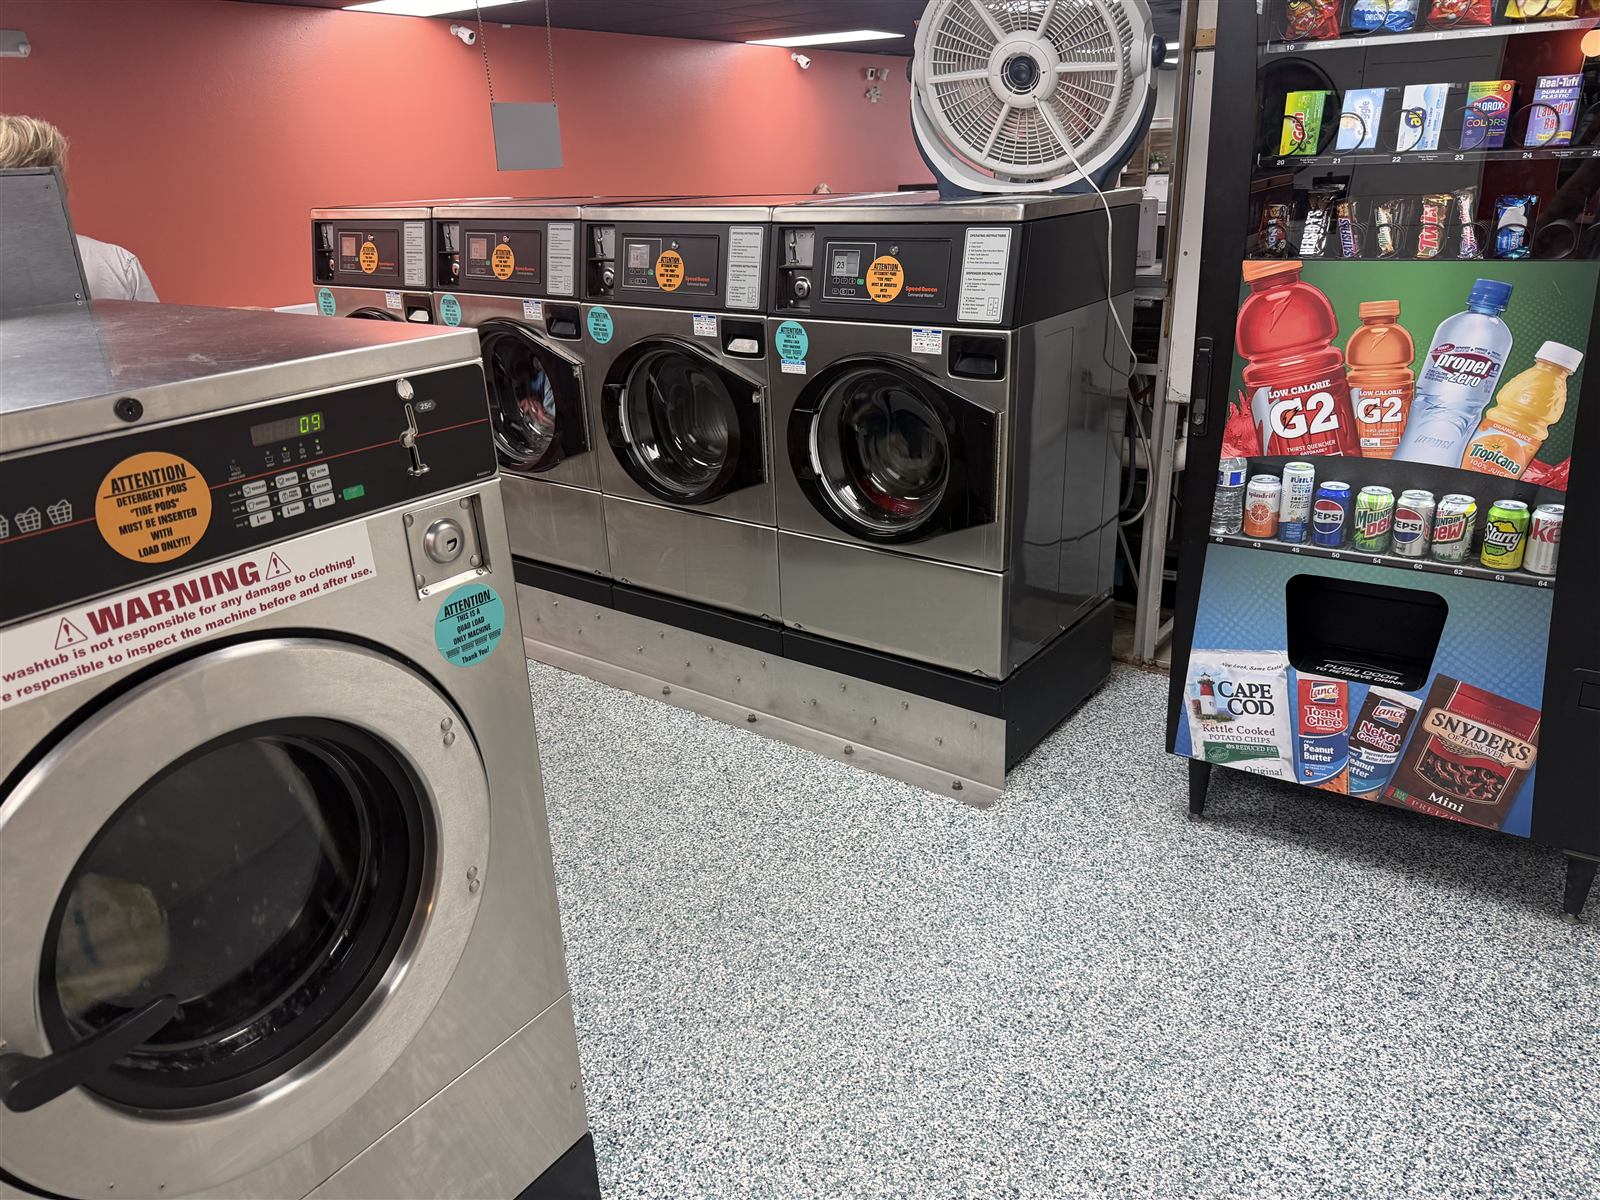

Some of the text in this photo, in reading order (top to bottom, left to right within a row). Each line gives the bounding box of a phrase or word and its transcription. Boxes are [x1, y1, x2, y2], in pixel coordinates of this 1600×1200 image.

[1539, 77, 1579, 88] Real-Tuff
[1544, 118, 1558, 129] Ba
[1418, 204, 1438, 252] Twix
[836, 261, 845, 269] 23
[874, 263, 898, 271] ATTENTION
[1434, 353, 1490, 376] propel
[1268, 380, 1331, 399] LOW CALORIE
[1448, 373, 1482, 388] zero
[1270, 392, 1340, 439] G2
[1357, 397, 1402, 424] G2
[300, 414, 321, 433] 09
[1492, 423, 1532, 442] ORANGE JUICE
[1307, 440, 1336, 451] QUENCHER
[1470, 444, 1520, 475] Tropicana
[1470, 458, 1488, 470] 100%
[111, 464, 186, 494] ATTENTION
[116, 483, 187, 507] DETERGENT PODS
[130, 498, 179, 517] "TIDE PODS"
[1313, 511, 1342, 520] PEPSI
[119, 508, 197, 535] MUST BE INSERTED
[1395, 521, 1422, 531] EPSI
[151, 527, 173, 541] WITH
[1484, 522, 1523, 551] Starry
[138, 536, 191, 558] LOAD ONLY!!!
[86, 561, 261, 635] WARNING
[444, 590, 491, 618] ATTENTION
[2, 555, 356, 682] washtub is not responsible for any damage to clothing!
[457, 612, 469, 623] THIS
[457, 616, 485, 634] QUAD LOAD
[16, 570, 373, 698] responsible to inspect the machine before and after use.
[453, 624, 492, 645] ONLY MACHINE
[462, 652, 478, 663] Thank
[479, 646, 490, 656] You!
[1325, 664, 1399, 680] PUSH DOOR
[1329, 668, 1373, 680] RETRIEVE
[1376, 677, 1405, 686] DRINK
[1218, 681, 1273, 699] CAPE
[1311, 686, 1338, 699] Lance
[1227, 698, 1274, 716] COD
[1305, 705, 1342, 720] Toast
[1372, 706, 1407, 720] Lance
[1202, 724, 1275, 736] Kettle Cooked
[1305, 716, 1342, 728] Chee
[1357, 731, 1395, 752] Cookies
[1360, 721, 1401, 745] Nekot
[1432, 712, 1531, 761] SNYDER'S
[1304, 744, 1334, 754] Peanut
[1448, 733, 1504, 759] OF HANOVER
[1304, 751, 1332, 762] Butter
[1350, 758, 1375, 772] eanut
[1244, 766, 1283, 776] Original
[1428, 792, 1464, 813] Mini
